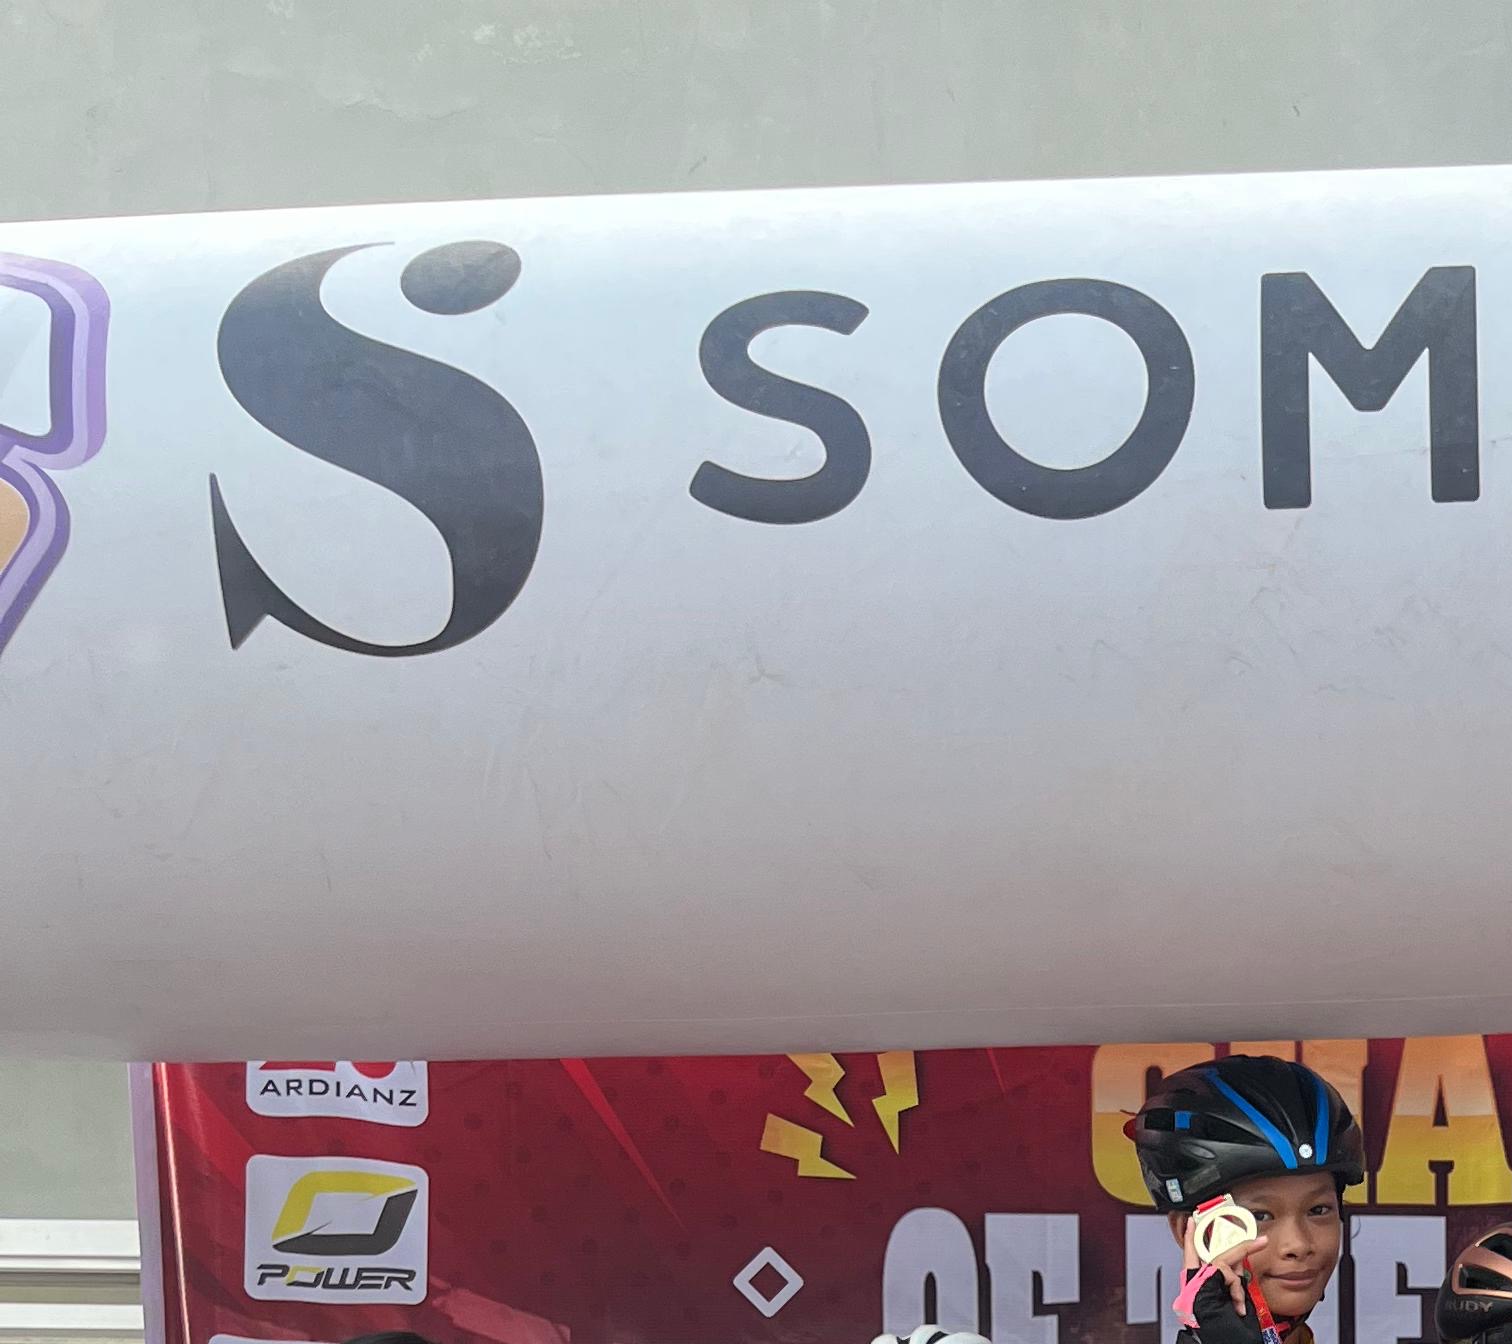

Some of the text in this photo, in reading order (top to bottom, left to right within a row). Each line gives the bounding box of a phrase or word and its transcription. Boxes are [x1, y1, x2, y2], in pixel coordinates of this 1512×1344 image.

[209, 240, 545, 658] S
[259, 1079, 417, 1107] ARDIANZ
[256, 1263, 416, 1291] POWER
